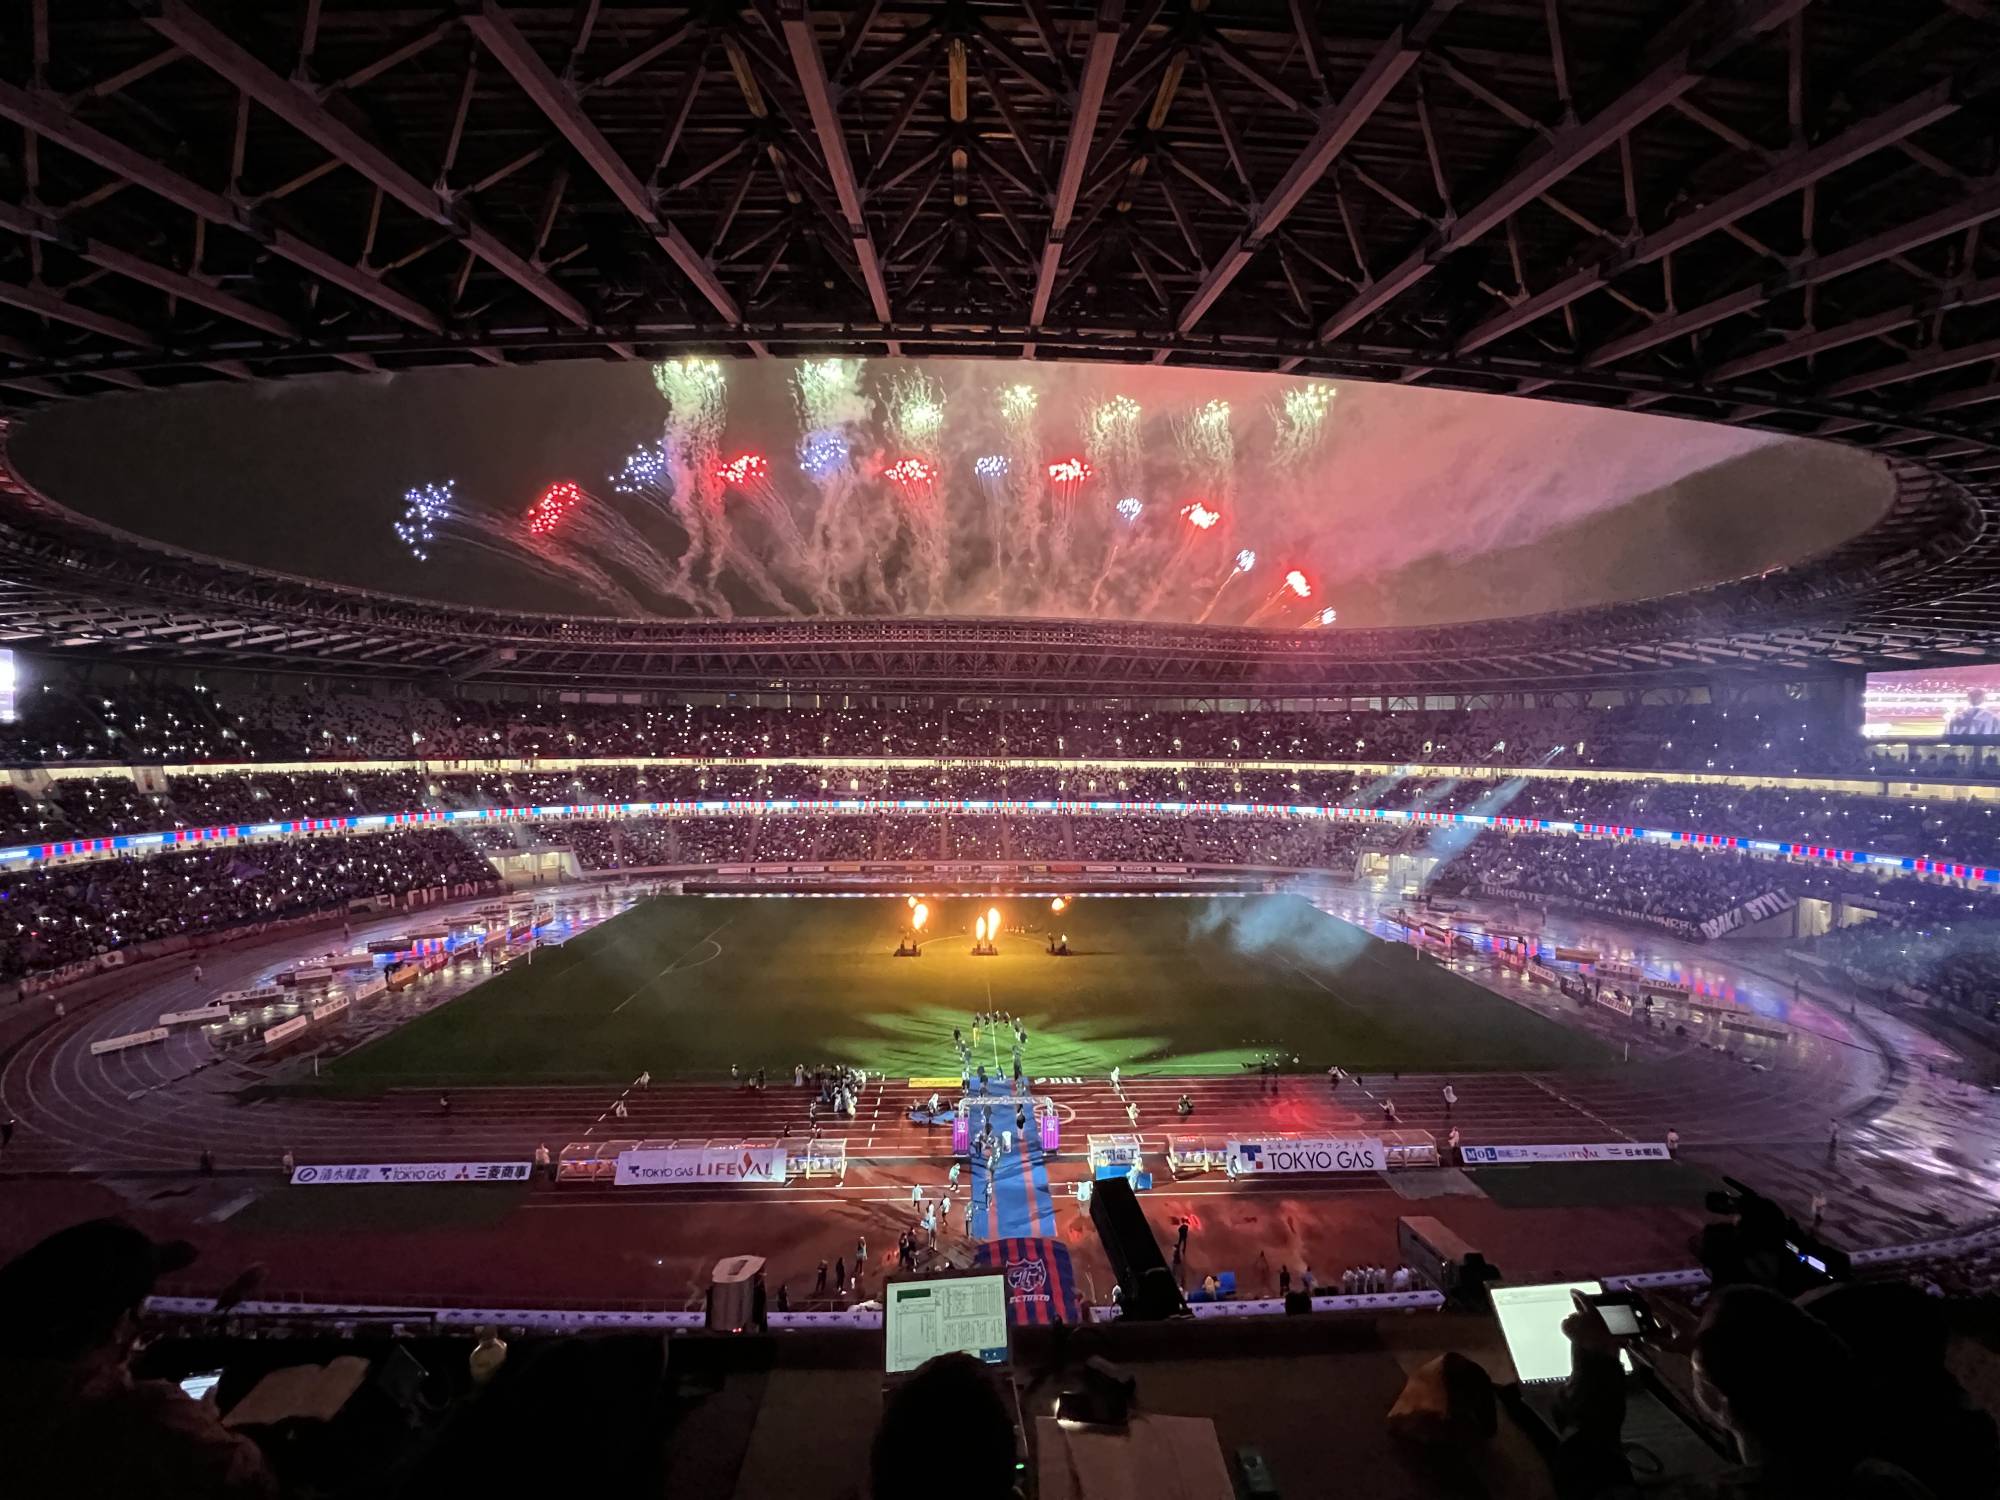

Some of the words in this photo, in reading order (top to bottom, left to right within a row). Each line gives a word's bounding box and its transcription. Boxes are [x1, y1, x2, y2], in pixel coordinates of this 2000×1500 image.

[1700, 908, 1744, 939] OSAKA
[1268, 1152, 1331, 1169] TOKYO
[1337, 1151, 1374, 1168] GAS
[1465, 1147, 1498, 1161] MOL
[393, 1169, 425, 1180] TOKYO
[427, 1169, 446, 1179] GAS
[474, 1166, 528, 1178] 三菱商事
[642, 1169, 672, 1177] TOKYO
[675, 1168, 694, 1177] GAS
[696, 1154, 773, 1178] LIFEVAL
